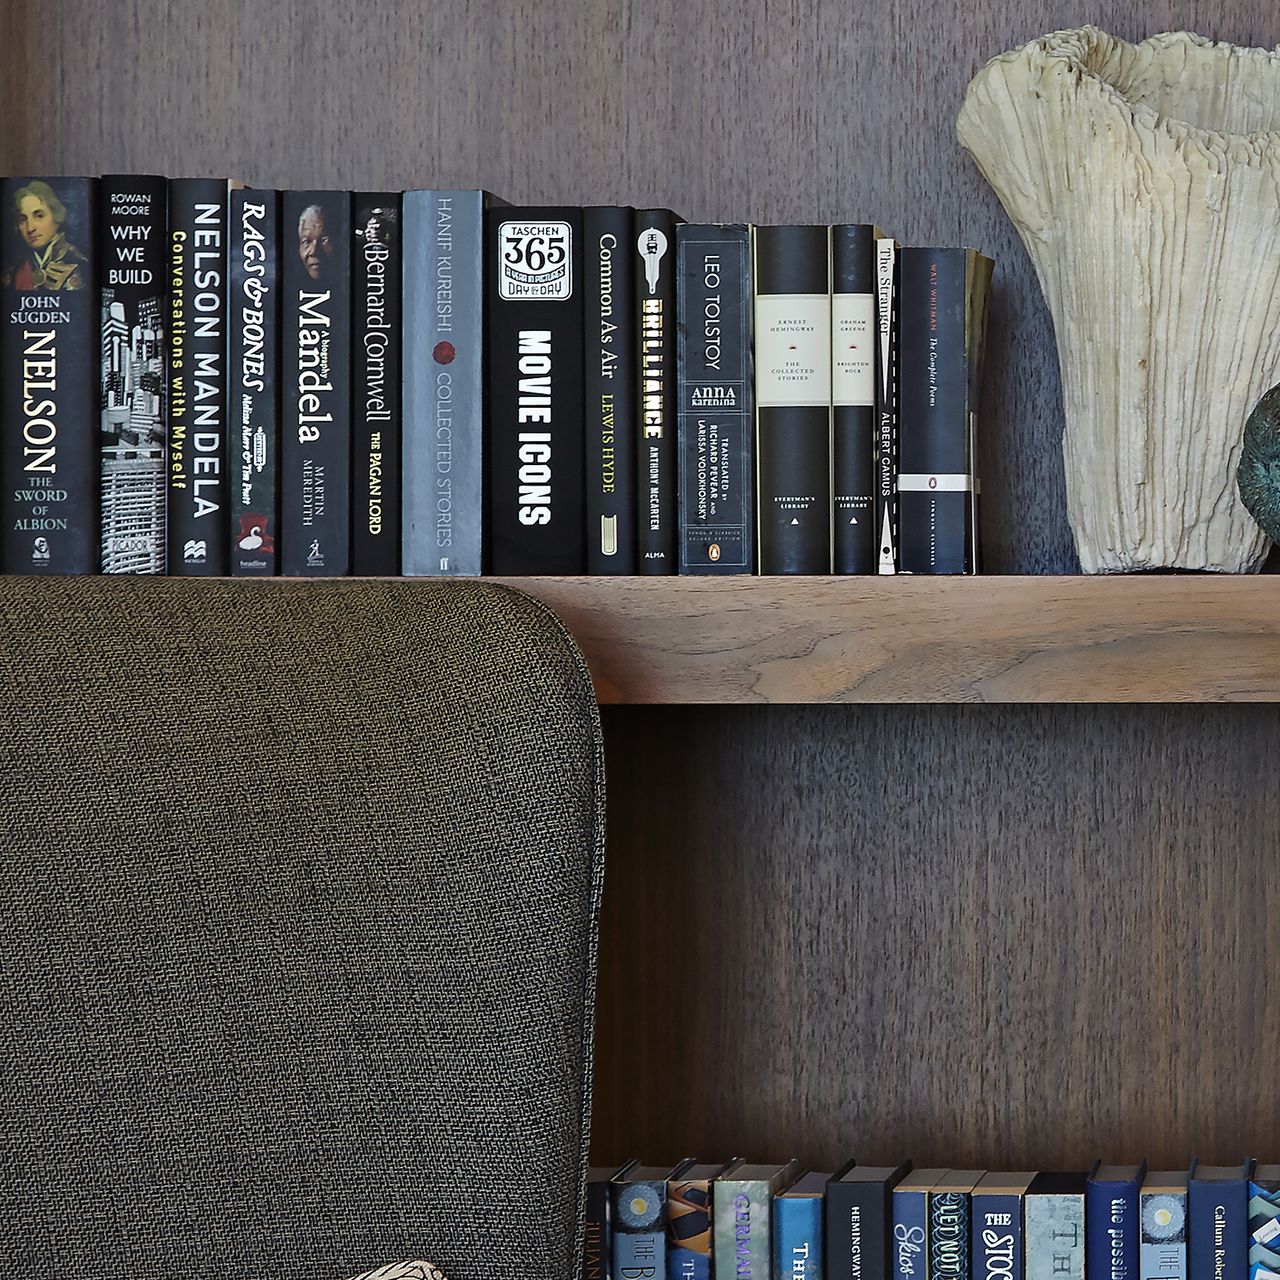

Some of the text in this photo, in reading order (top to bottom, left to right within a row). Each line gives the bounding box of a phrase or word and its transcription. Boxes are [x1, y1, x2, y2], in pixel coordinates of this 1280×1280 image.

[110, 226, 152, 240] WHY
[111, 193, 151, 203] ROWAN
[111, 205, 150, 215] MOORE
[511, 227, 559, 236] TASCHEN
[19, 296, 60, 311] JOHN
[109, 269, 152, 284] BUILD
[116, 247, 144, 262] WE
[437, 198, 452, 331] HANIF KUREISHI
[505, 237, 565, 273] 365
[364, 250, 391, 422] Bernard Cornwell
[600, 234, 618, 379] Common As Air
[705, 255, 720, 370] LEO TOLSTOY
[23, 330, 56, 473] NELSON
[171, 231, 187, 488] Conversations with Myself
[194, 204, 220, 518] NELSON MANDELA
[298, 290, 333, 444] Mandela
[436, 372, 452, 547] COLLECTED STORIES
[518, 331, 551, 525] MOVIE ICONS
[602, 394, 614, 493] LEWIS HYDE
[881, 412, 890, 496] ALBERT CAMUS
[369, 432, 382, 534] THE PAGAN LORD
[1215, 1206, 1226, 1246] Callum
